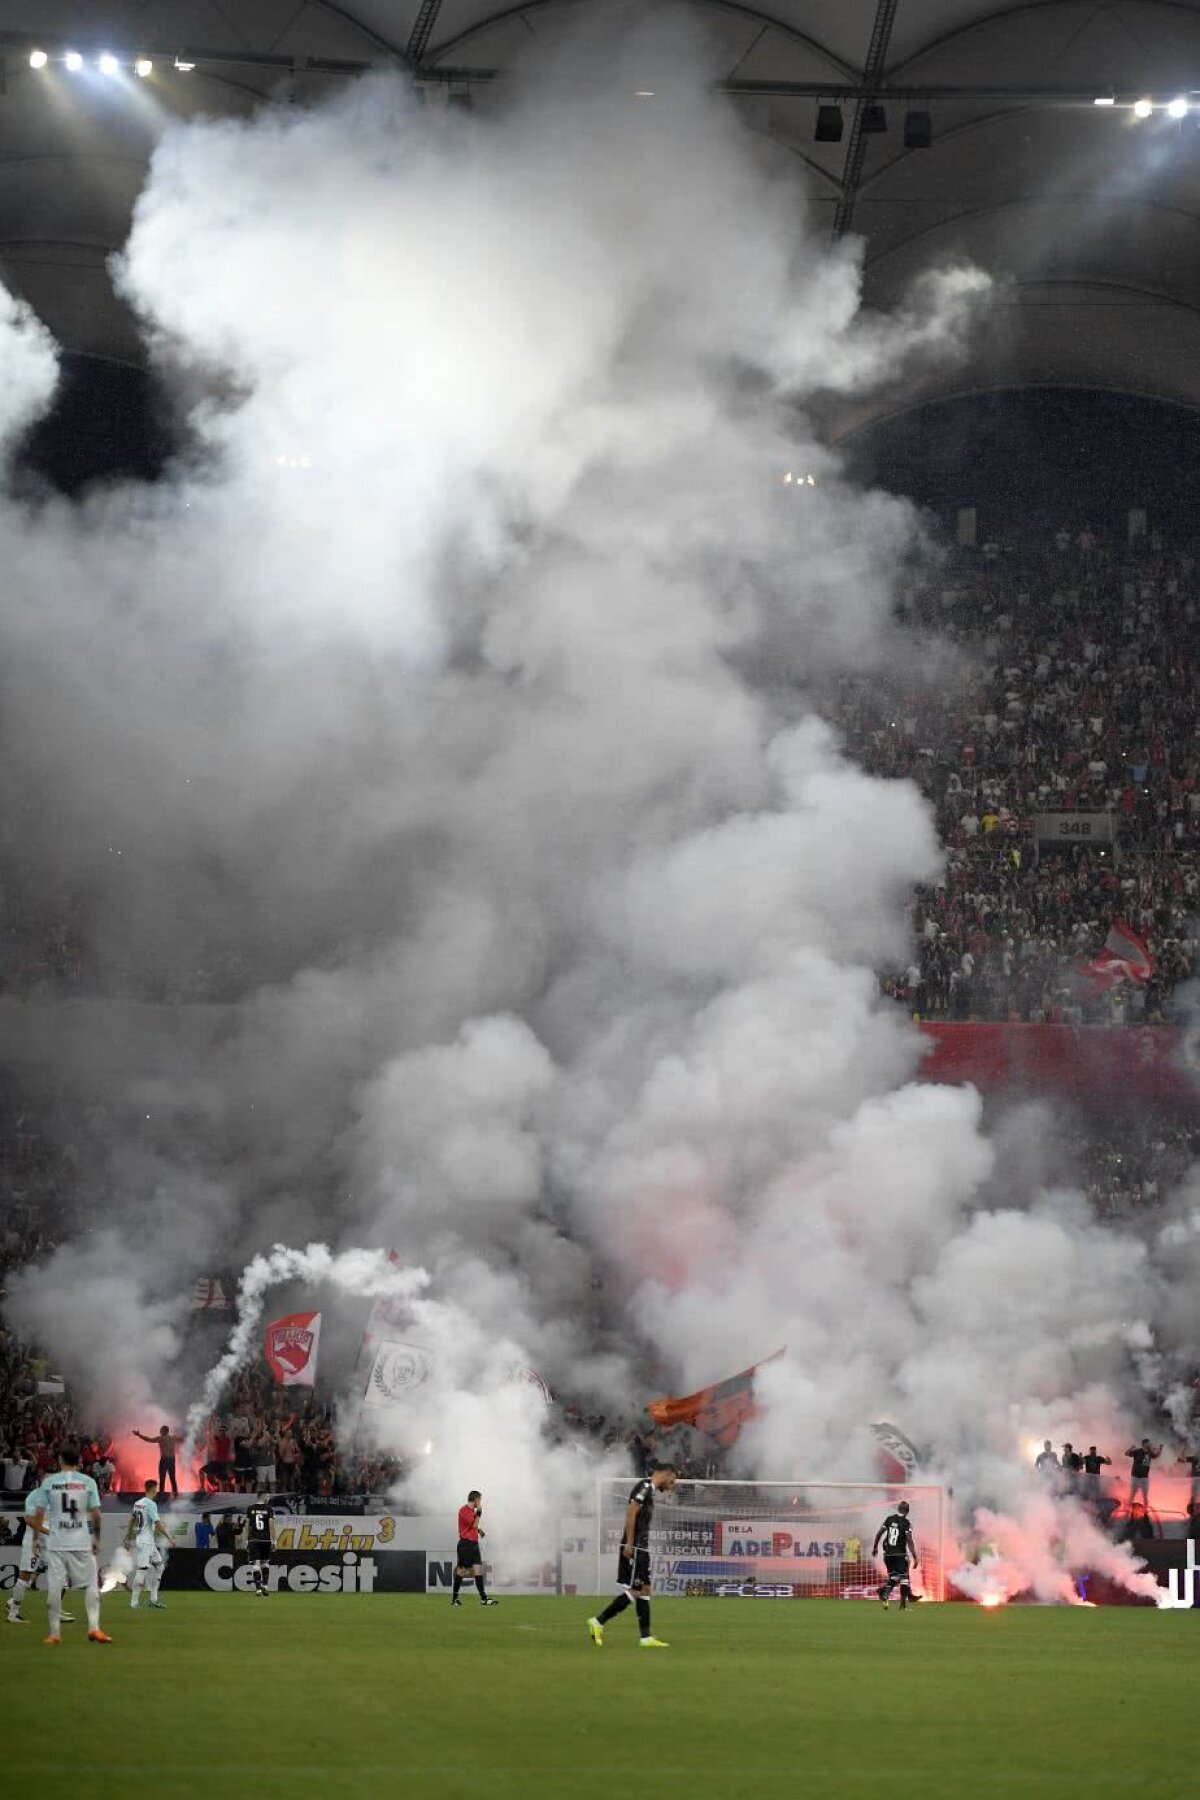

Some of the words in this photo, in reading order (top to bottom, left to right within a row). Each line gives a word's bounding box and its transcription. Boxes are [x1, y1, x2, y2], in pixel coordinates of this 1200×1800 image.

[1059, 822, 1092, 835] 348
[61, 1492, 79, 1519] 4
[255, 1513, 265, 1531] 6
[728, 1525, 740, 1533] DE
[742, 1525, 753, 1533] LA
[203, 1551, 379, 1594] Ceresit
